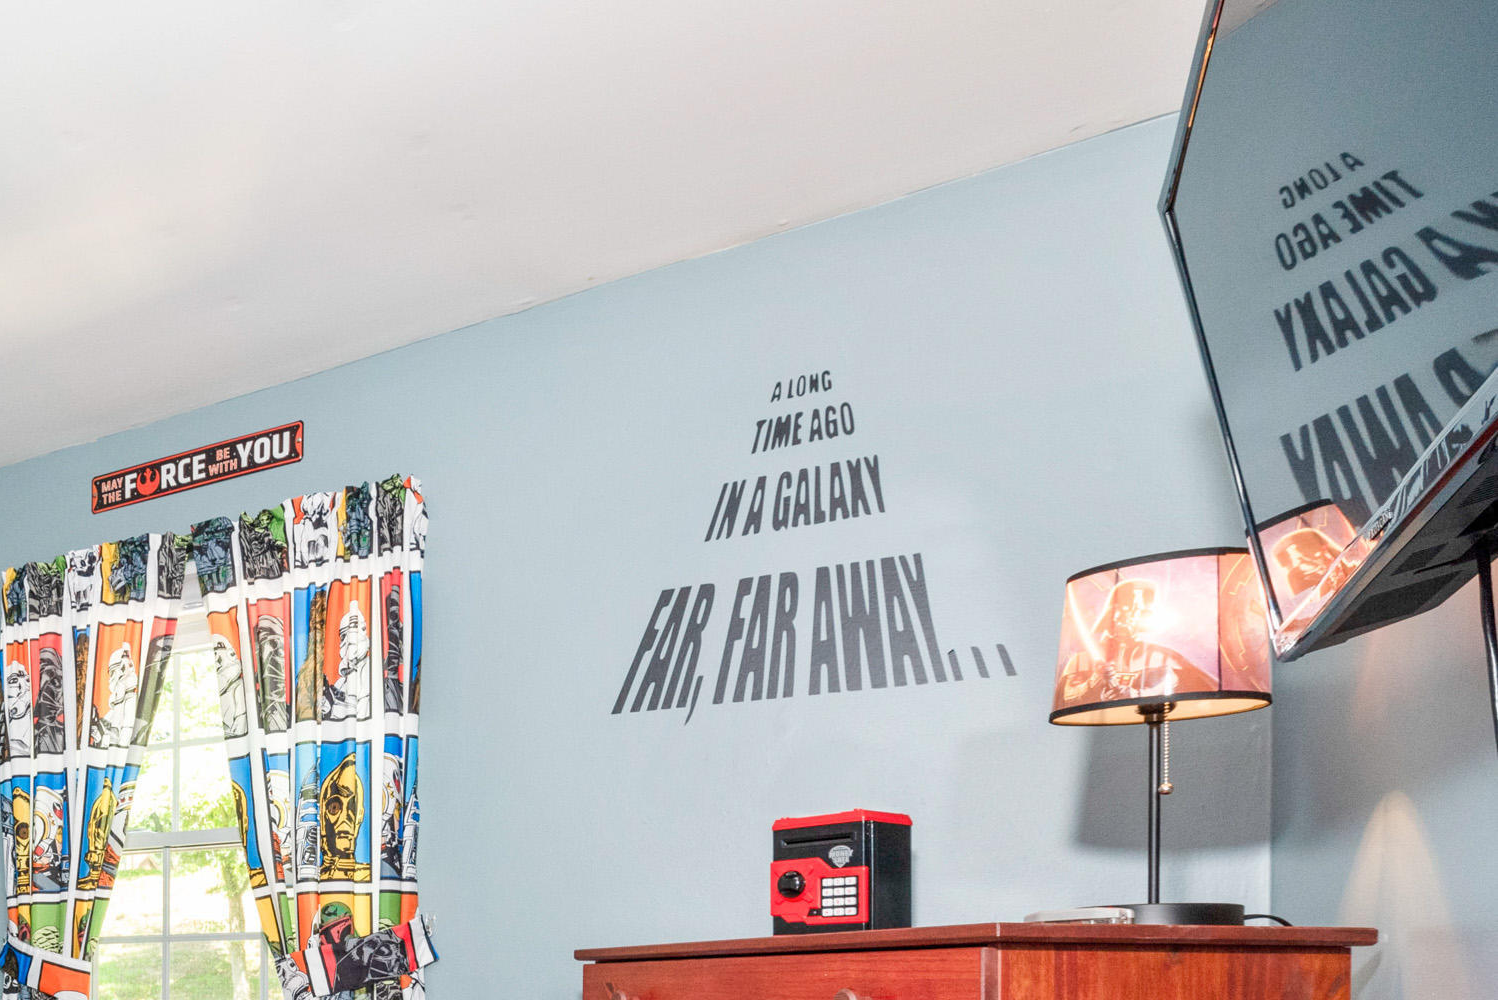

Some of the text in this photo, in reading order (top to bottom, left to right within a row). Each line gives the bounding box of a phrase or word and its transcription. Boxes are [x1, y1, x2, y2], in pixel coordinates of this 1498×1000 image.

[770, 370, 833, 403] A LONG
[751, 402, 856, 455] TIME AGO
[215, 448, 231, 462] BE
[235, 430, 291, 468] YOU
[208, 459, 239, 477] WITH
[101, 476, 123, 494] MAY
[102, 490, 123, 506] THE
[704, 454, 887, 543] IN A GALAXY
[611, 582, 716, 726] FAR,
[712, 572, 800, 705] FAR
